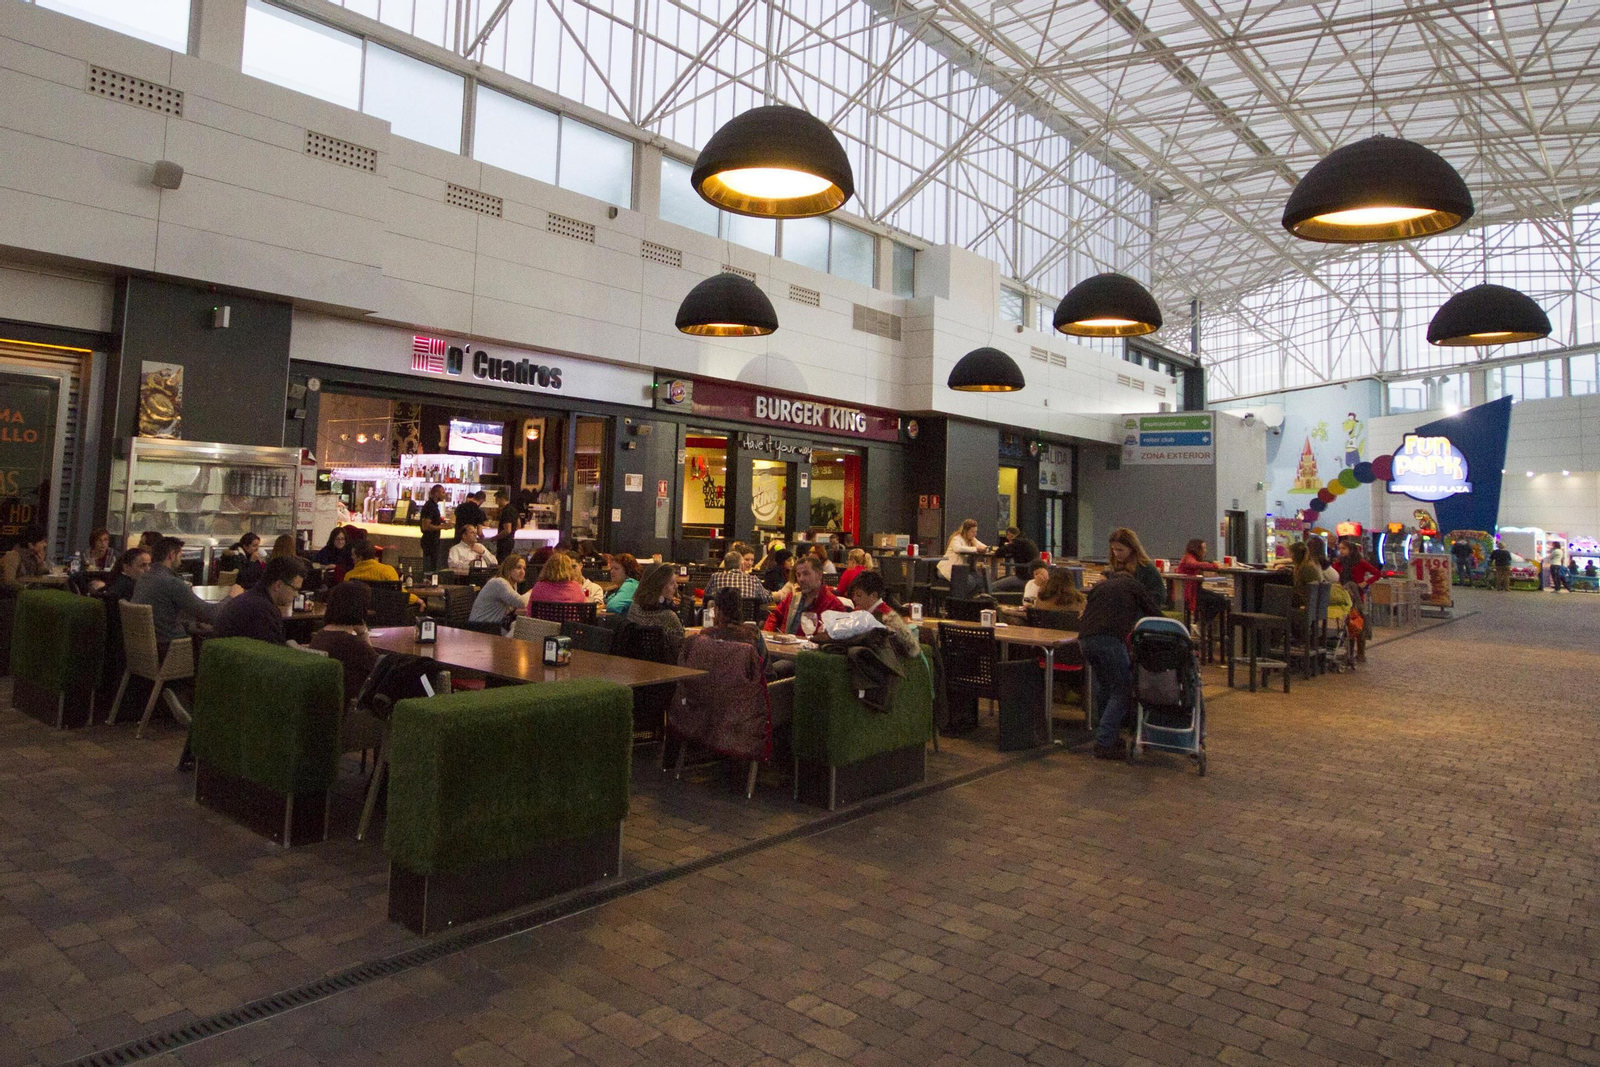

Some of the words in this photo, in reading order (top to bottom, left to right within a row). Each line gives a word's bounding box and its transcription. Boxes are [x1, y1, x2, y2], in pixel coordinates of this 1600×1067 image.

[755, 395, 823, 427] BURGER
[829, 407, 867, 433] KING
[743, 436, 764, 451] Have
[765, 434, 773, 453] it
[1405, 435, 1452, 456] Fun
[1141, 452, 1165, 460] ZONA
[1167, 451, 1211, 460] EXTERIOR
[1390, 484, 1437, 493] SERRALLO
[1440, 485, 1470, 494] PLAZA
